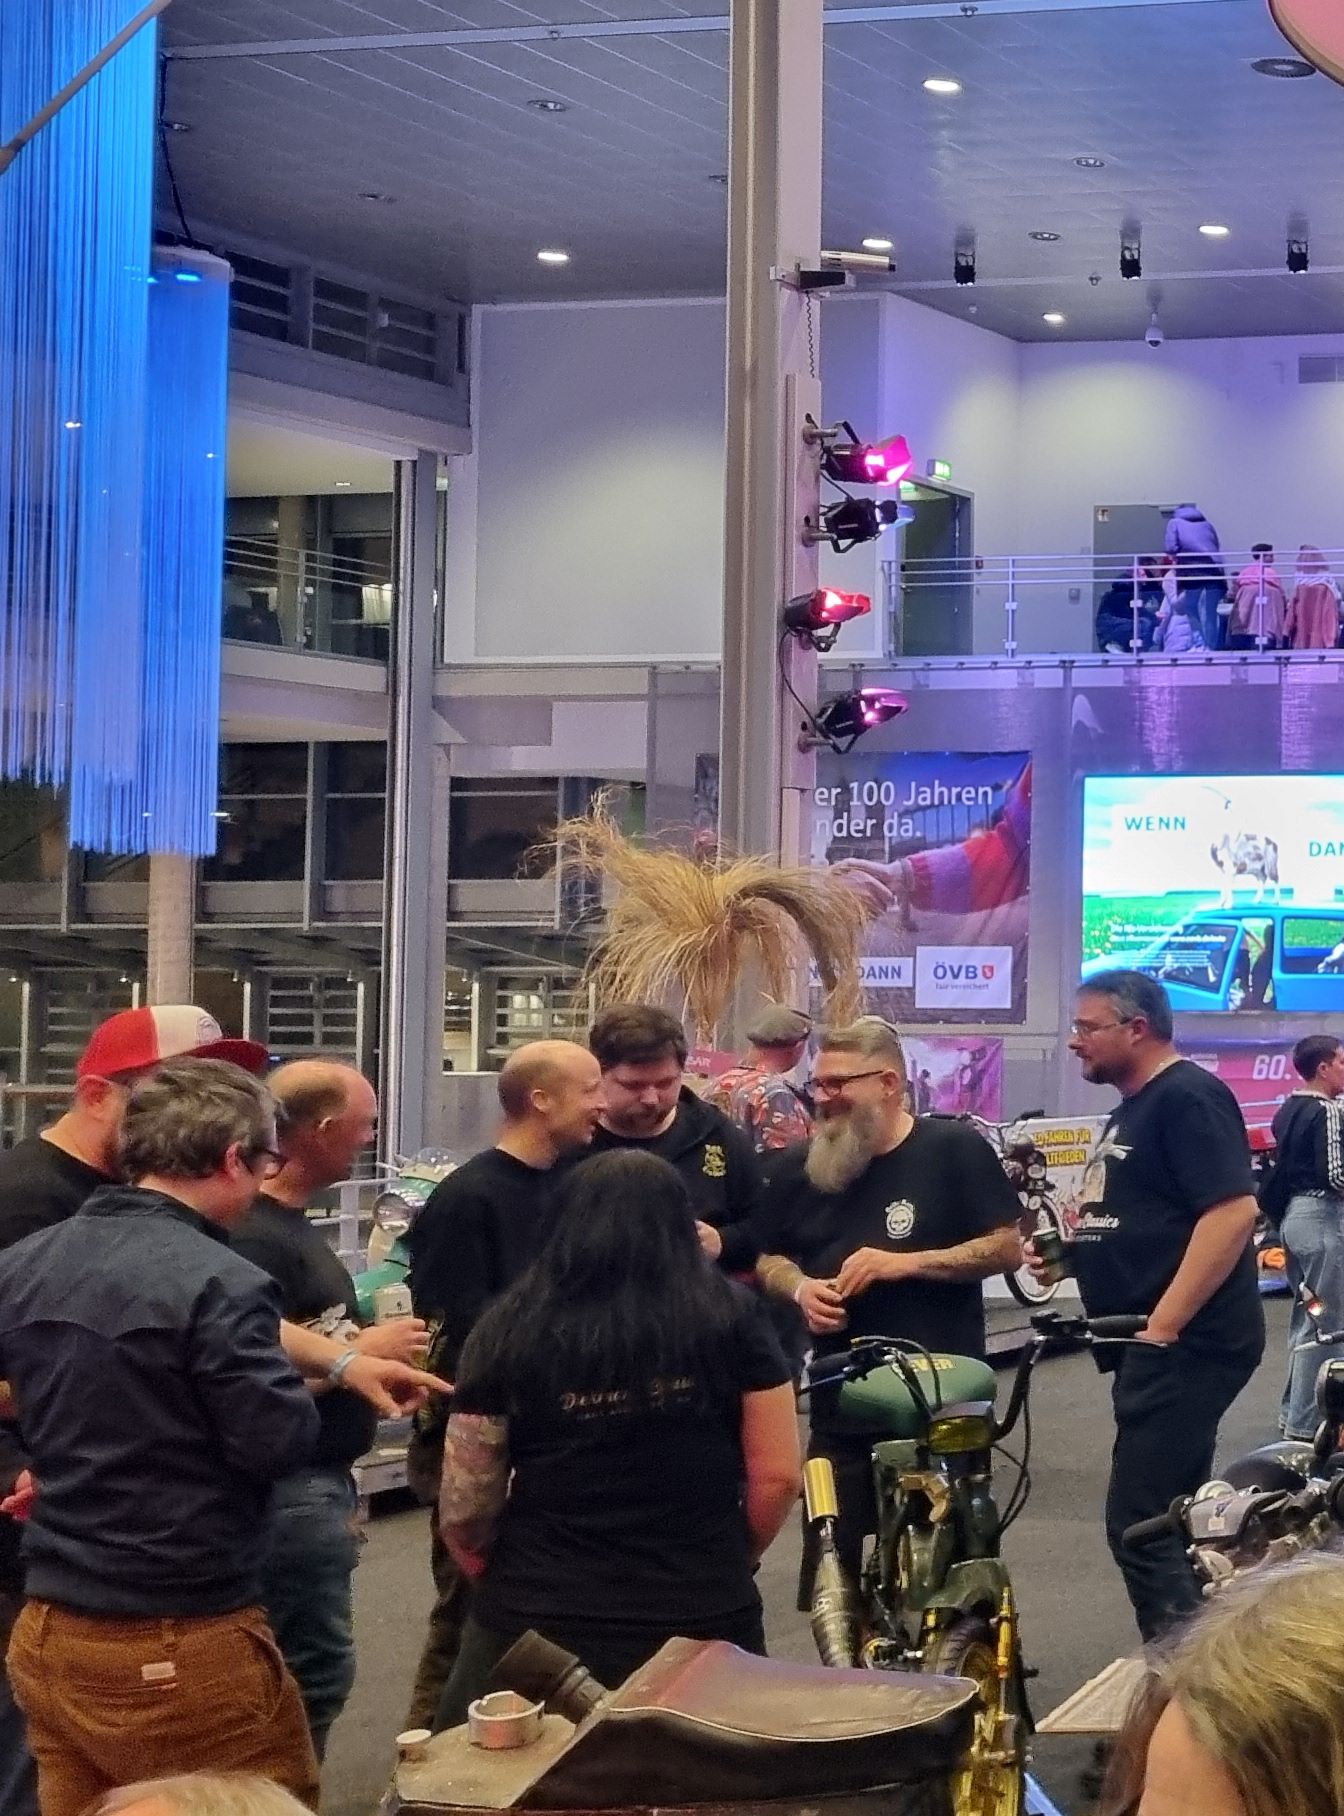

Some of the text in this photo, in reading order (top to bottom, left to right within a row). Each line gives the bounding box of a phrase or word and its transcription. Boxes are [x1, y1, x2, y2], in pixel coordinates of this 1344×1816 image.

[849, 780, 895, 806] 100
[903, 779, 993, 806] Jahren
[816, 811, 922, 838] nder da.
[1124, 815, 1188, 831] WENN
[933, 961, 978, 981] ÖVB
